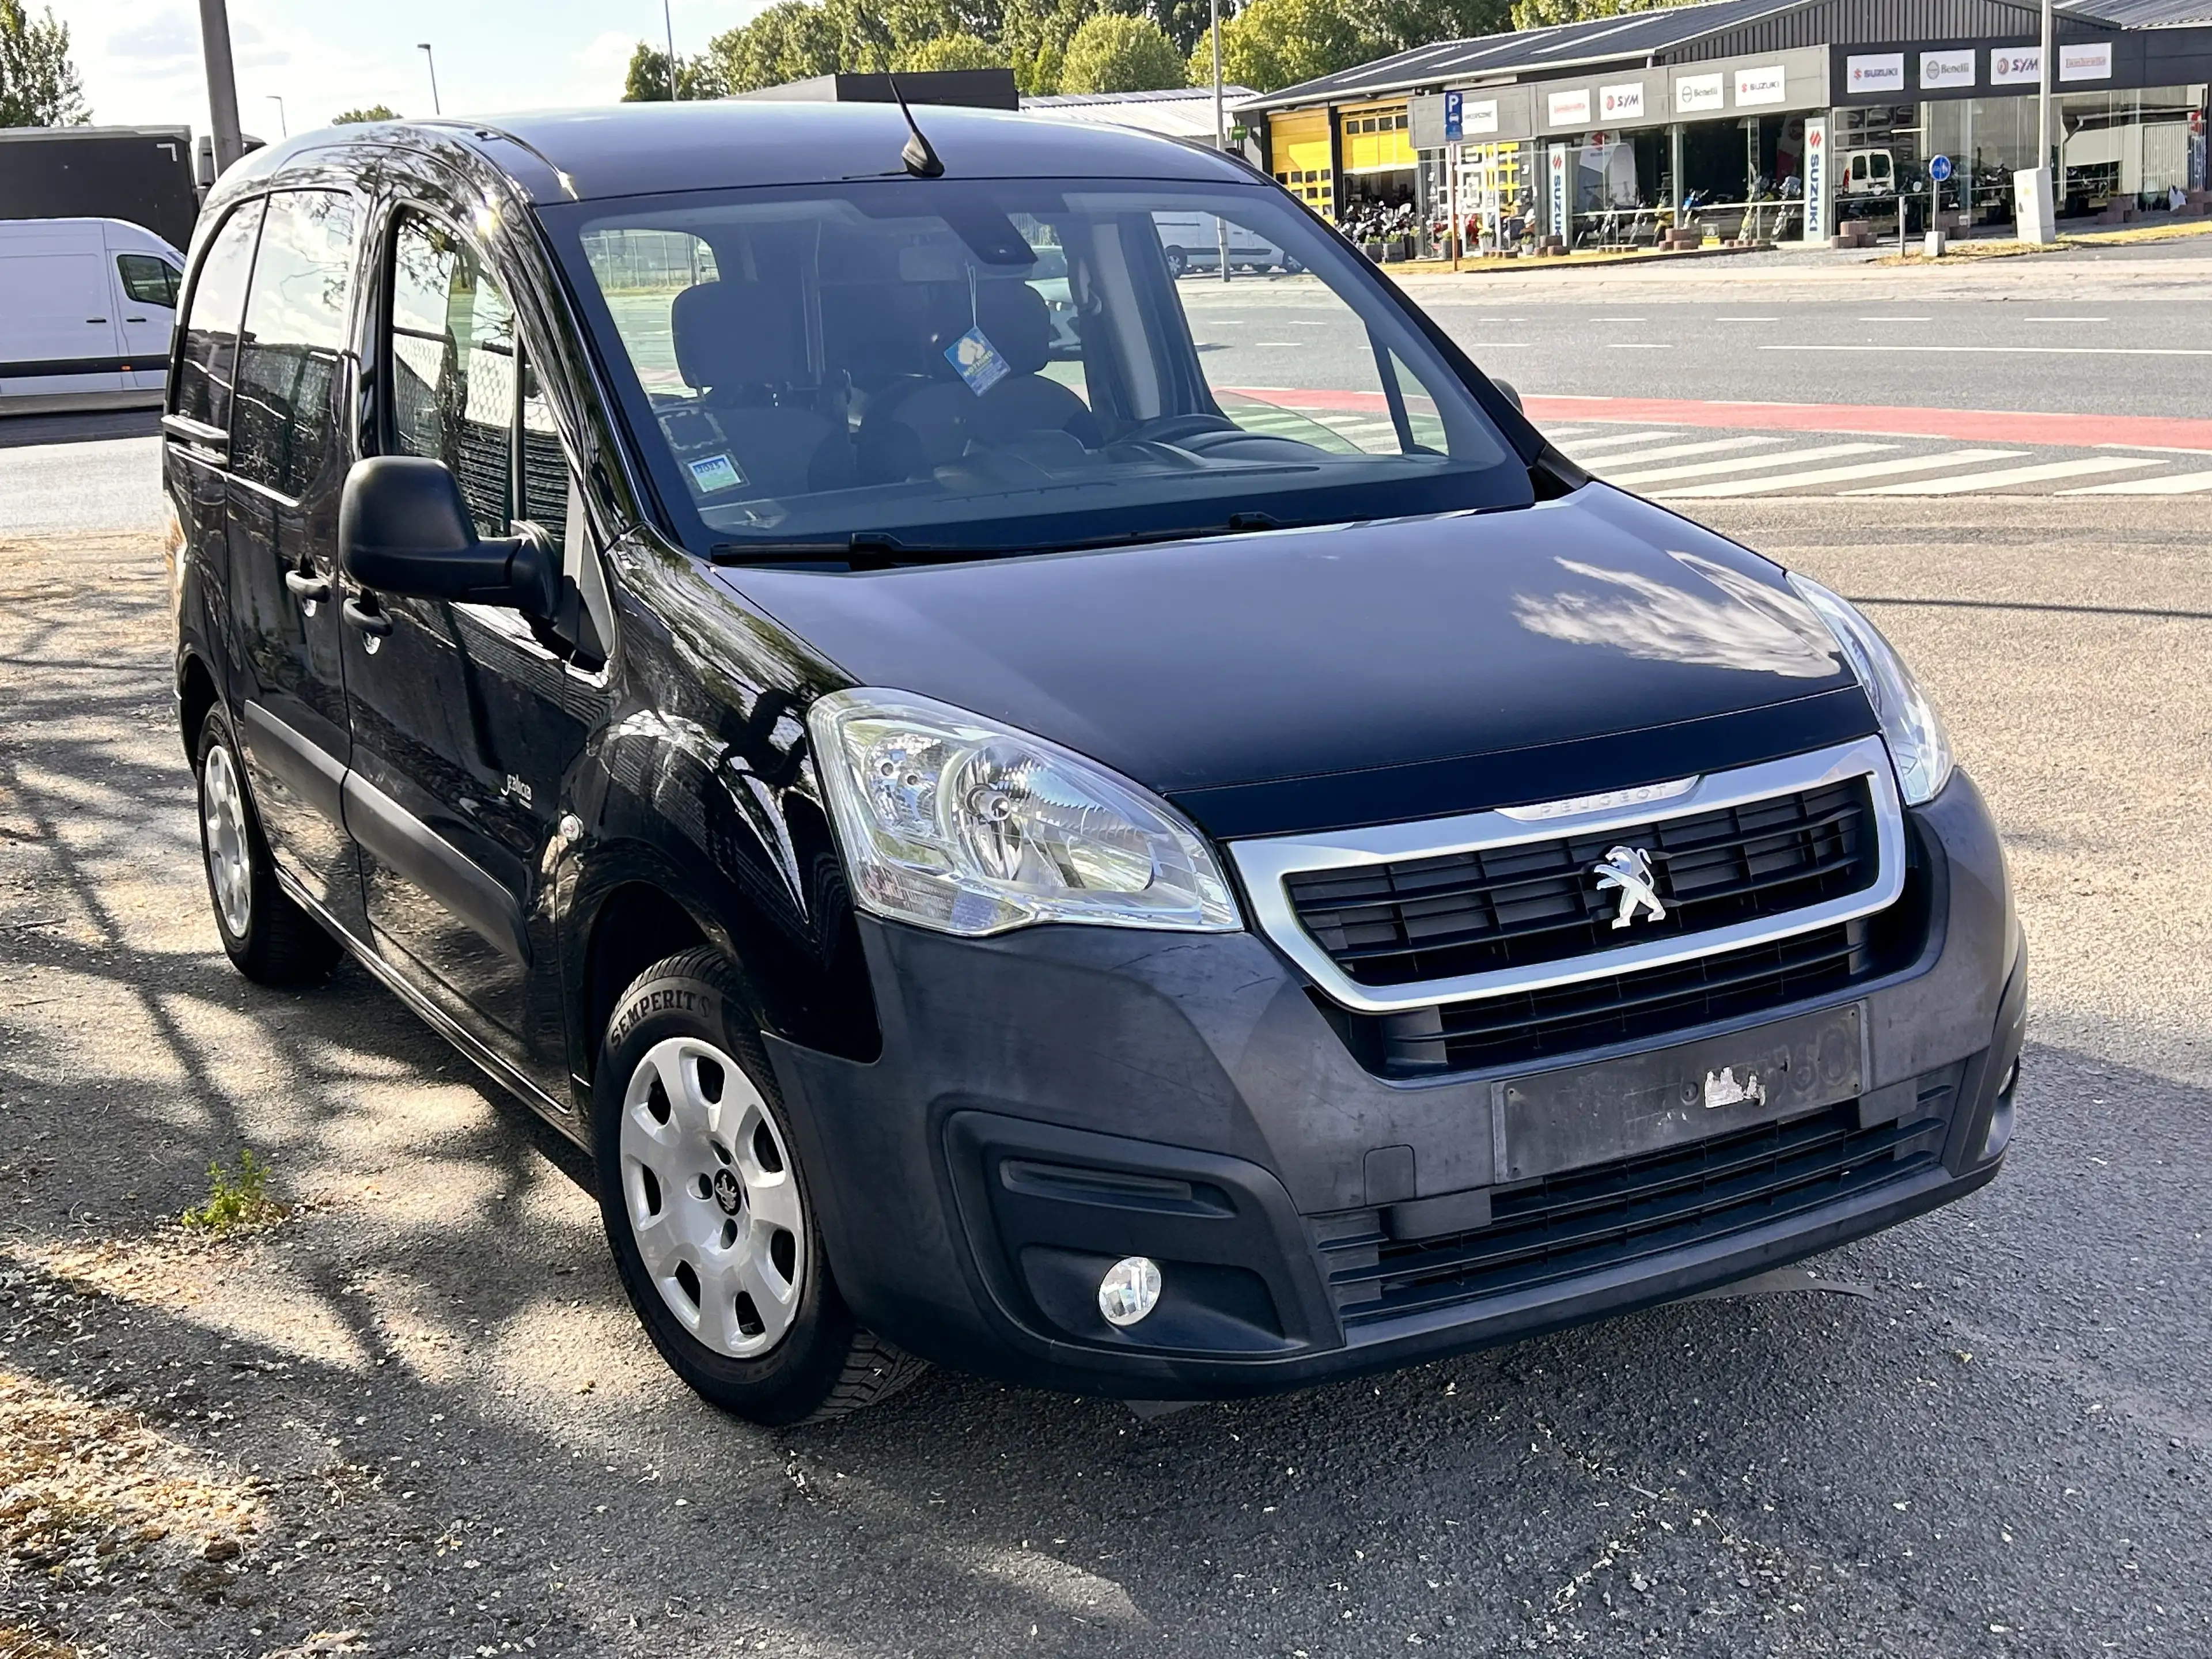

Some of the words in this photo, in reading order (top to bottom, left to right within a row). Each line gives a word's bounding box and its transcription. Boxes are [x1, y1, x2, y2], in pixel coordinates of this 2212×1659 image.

[1940, 62, 1969, 74] Benelli
[2012, 58, 2039, 73] SYM
[1863, 68, 1898, 78] SUZUKI
[1694, 86, 1718, 97] Benelli
[1749, 81, 1780, 90] SUZUKI
[1448, 94, 1459, 112] P
[1617, 94, 1639, 108] SYM
[1809, 153, 1819, 232] SUZUKI
[1539, 785, 1667, 817] PEUGEOT
[611, 989, 698, 1051] SEMPERIT
